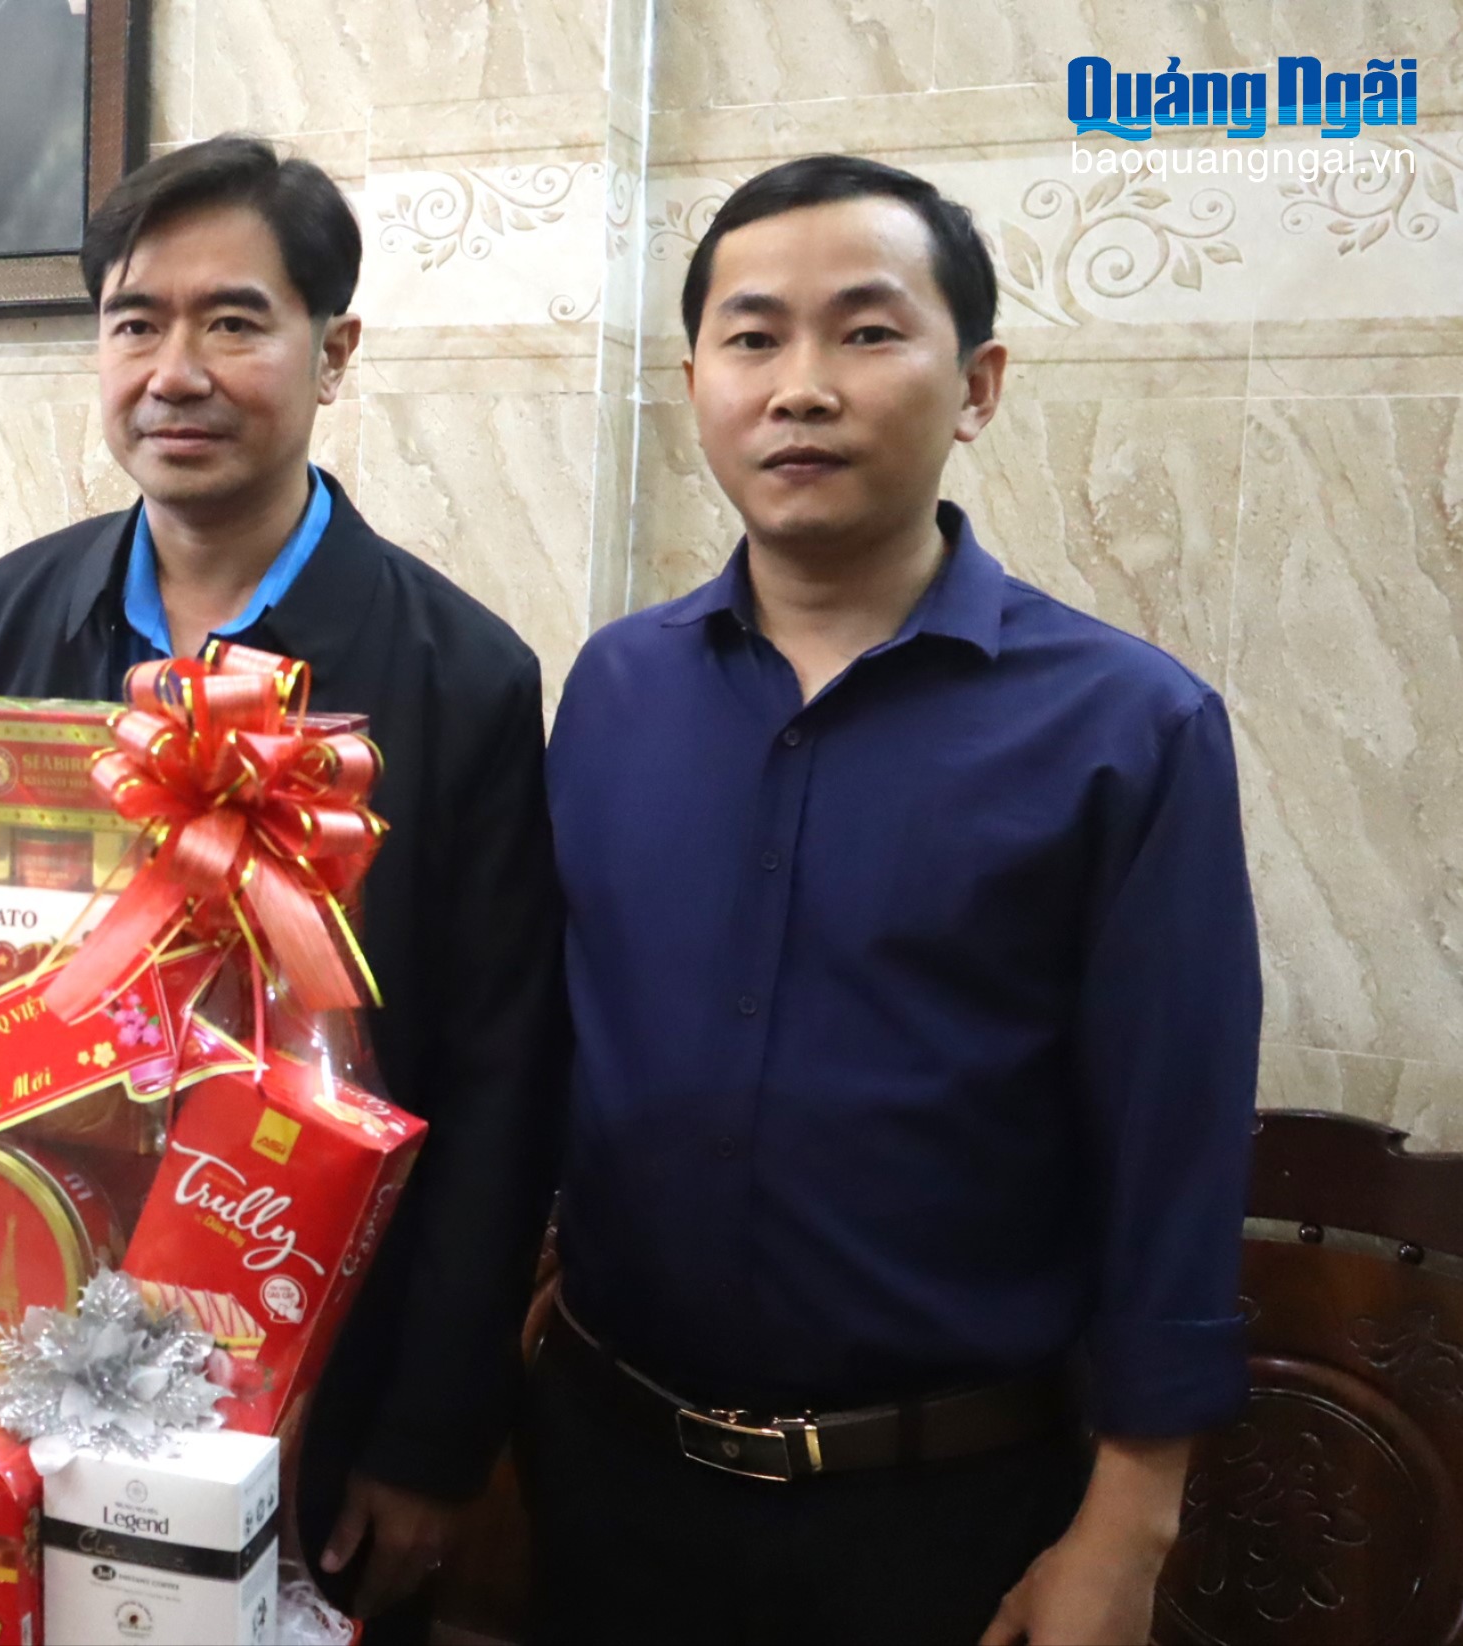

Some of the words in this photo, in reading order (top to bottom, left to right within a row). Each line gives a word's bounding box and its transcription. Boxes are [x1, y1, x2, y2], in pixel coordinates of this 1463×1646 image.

[8, 1066, 52, 1103] Mới
[170, 1140, 326, 1277] Trully
[103, 1505, 170, 1536] Legend
